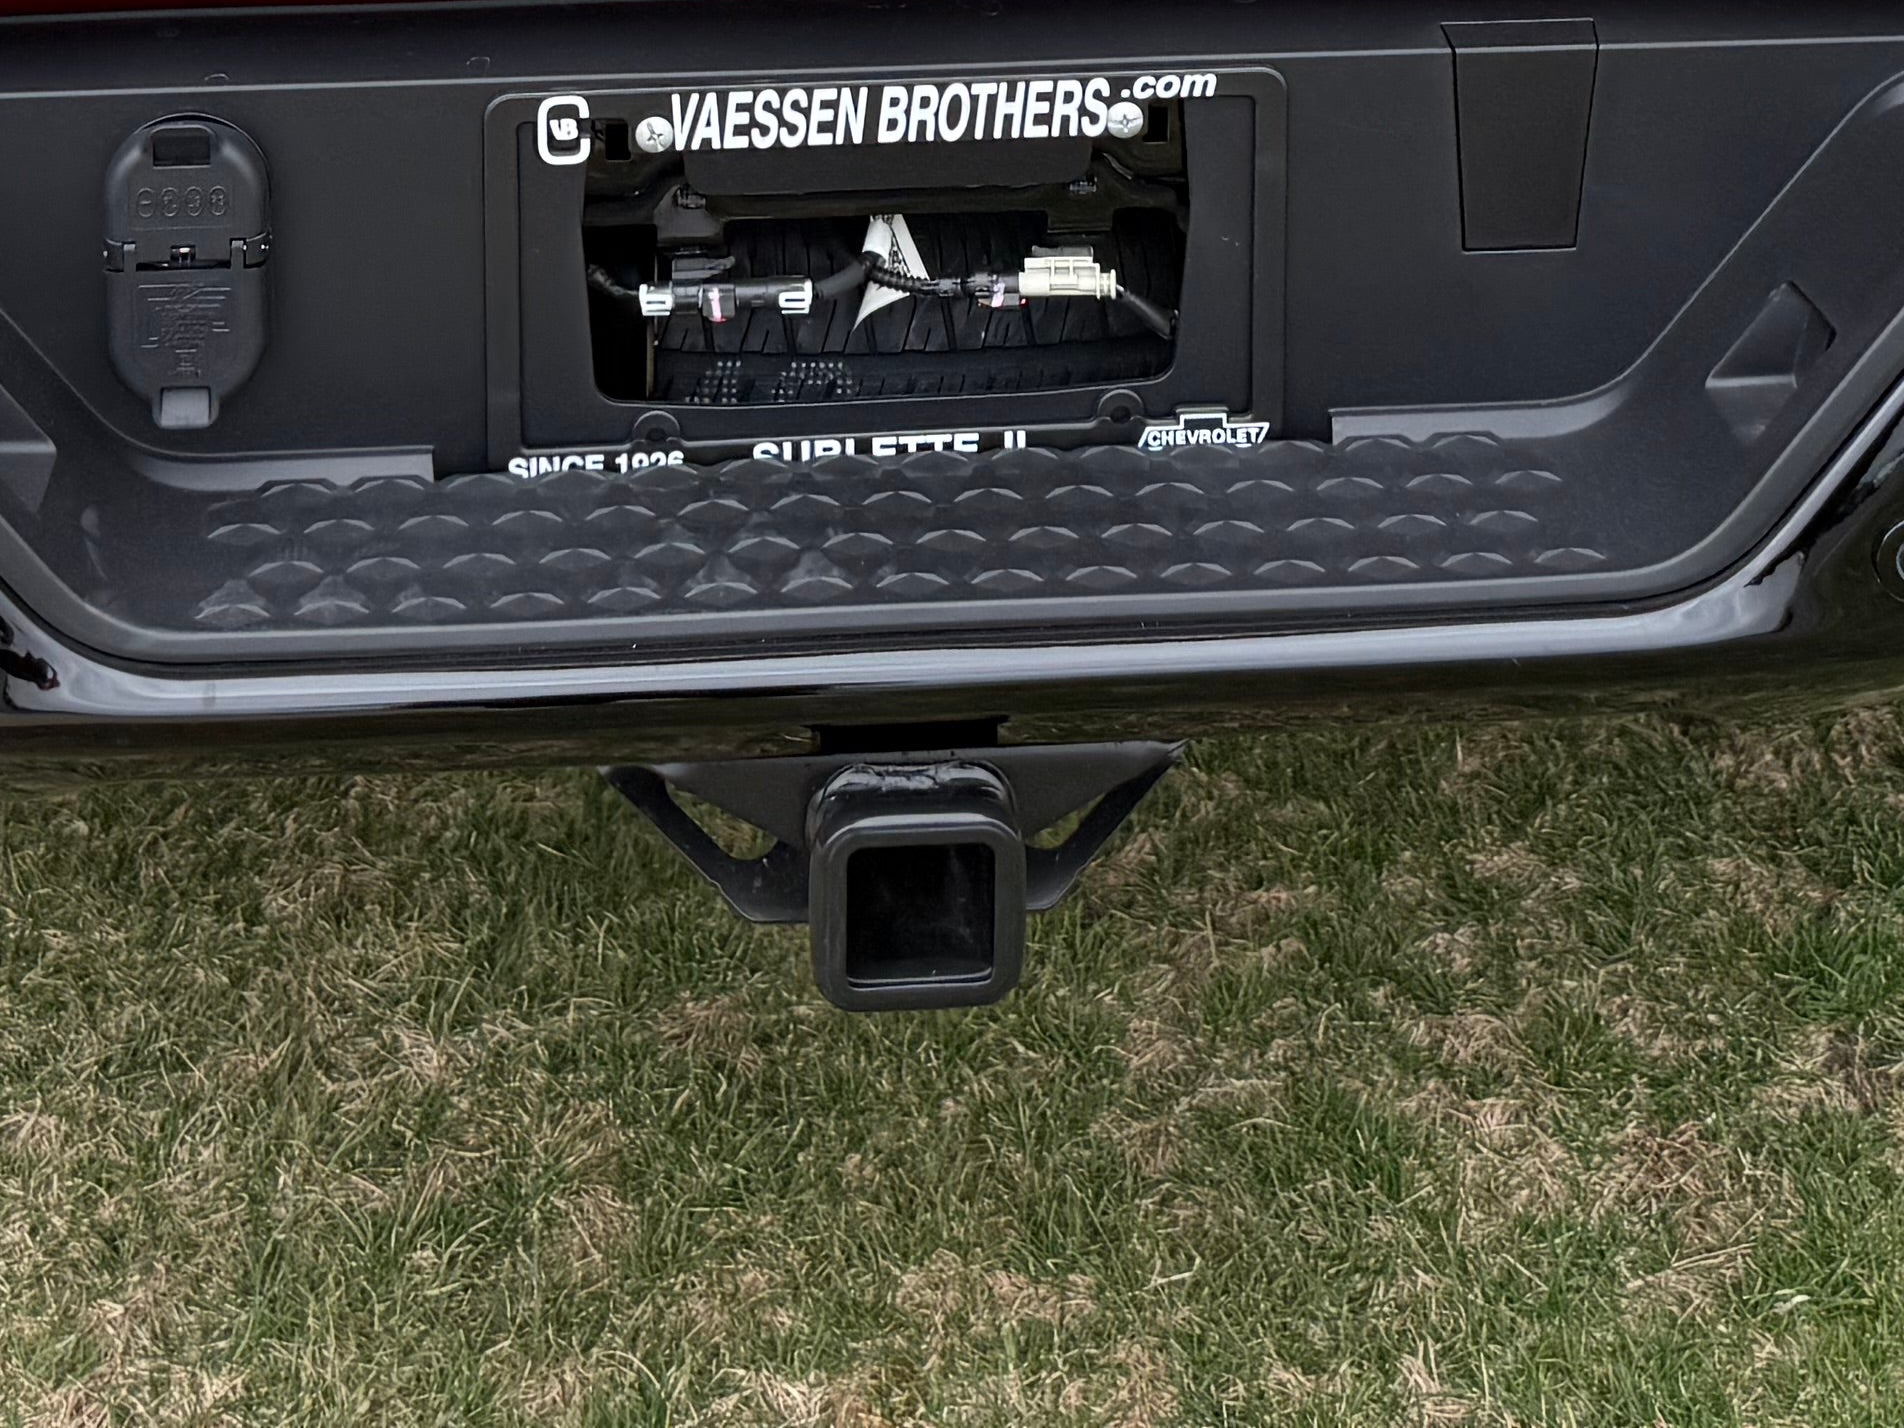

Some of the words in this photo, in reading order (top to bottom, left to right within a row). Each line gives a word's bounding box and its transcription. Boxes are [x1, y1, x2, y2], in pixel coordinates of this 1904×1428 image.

[670, 86, 868, 151] VAESSEN
[877, 77, 1111, 144] BROTHERS
[1147, 427, 1260, 447] CHEVROLET
